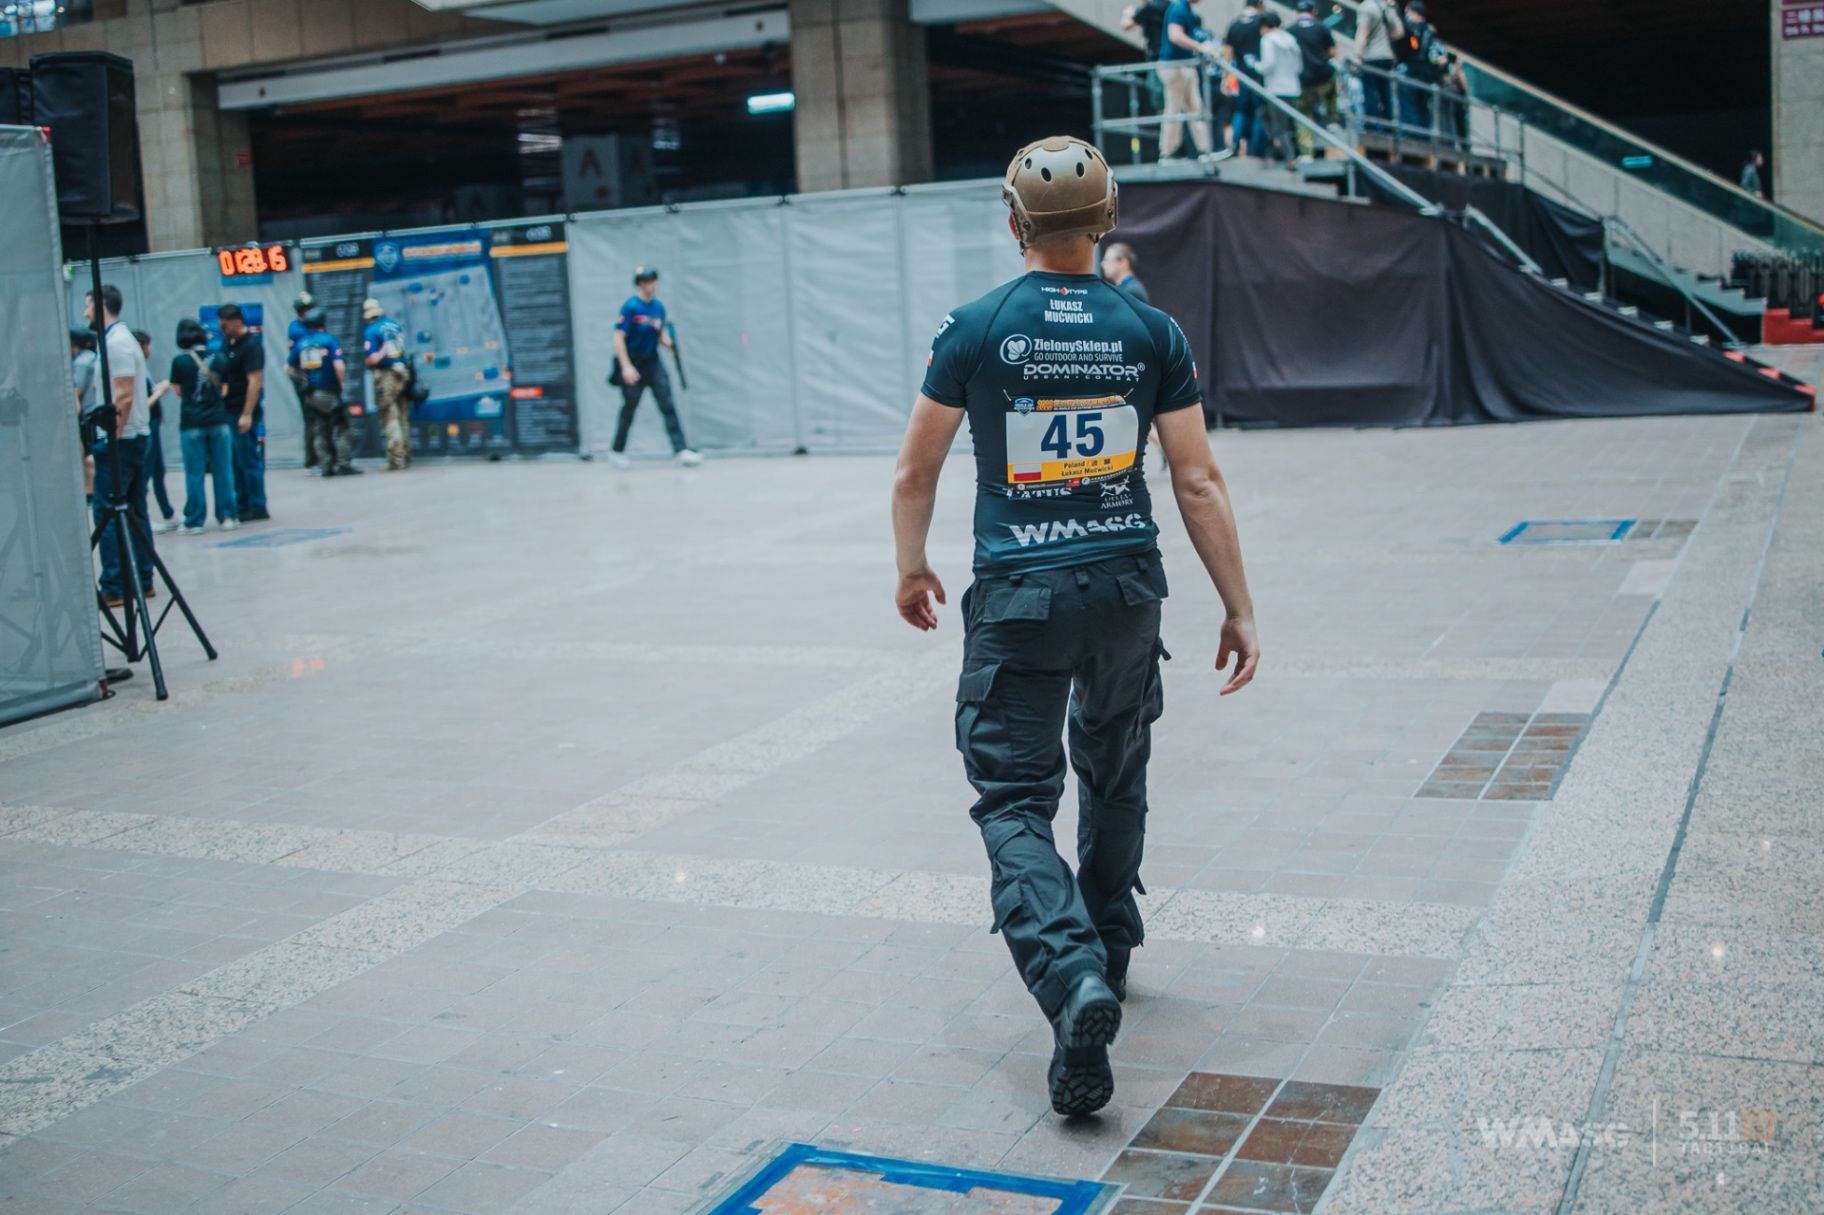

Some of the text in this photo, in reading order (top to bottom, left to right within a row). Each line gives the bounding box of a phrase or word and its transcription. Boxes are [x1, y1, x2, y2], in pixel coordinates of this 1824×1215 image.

[1050, 299, 1083, 312] ŁUKASZ
[1044, 310, 1094, 324] MUĆWICKI
[1033, 338, 1123, 353] ZielonySklep.pl
[1034, 352, 1123, 362] GO OUTDOOR AND SURVIVE
[1085, 374, 1140, 382] COMBAT
[1040, 412, 1105, 459] 45
[1063, 461, 1086, 469] Poland
[1061, 469, 1083, 477] Łukasz
[1009, 513, 1146, 547] WMASG
